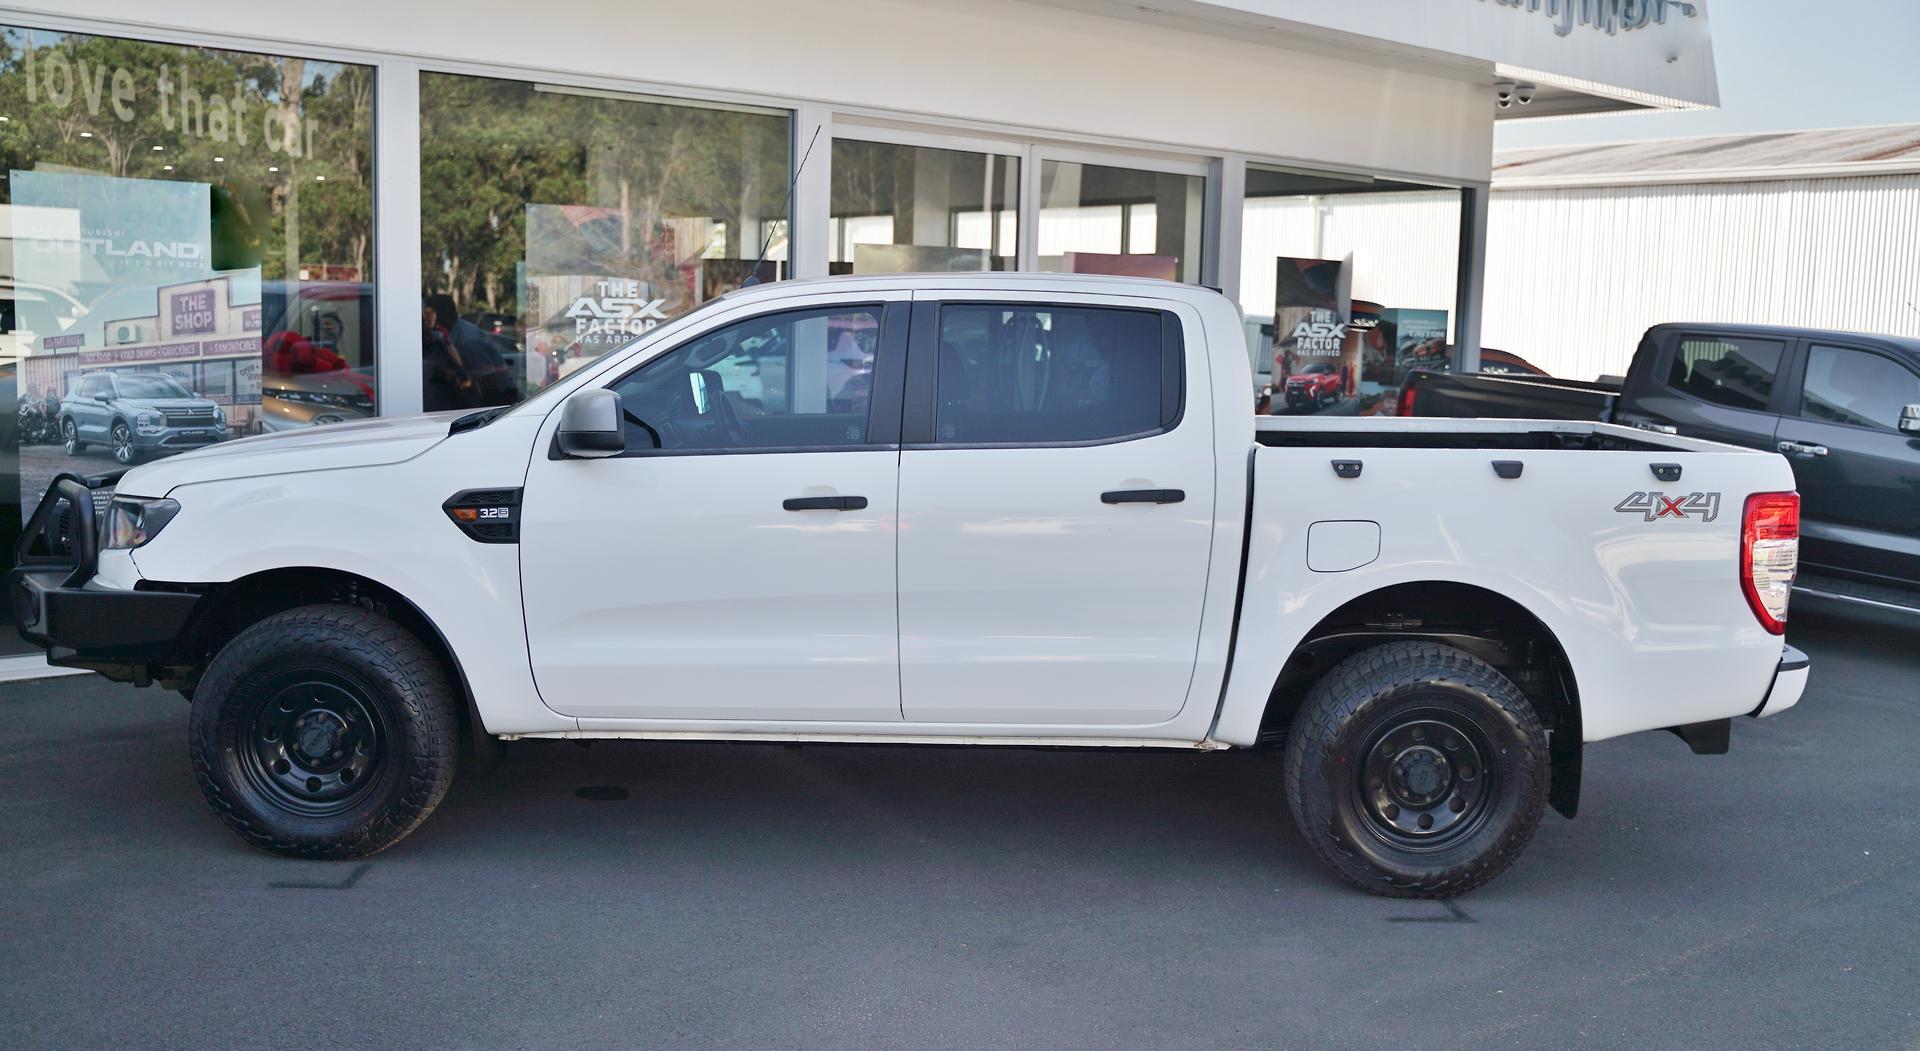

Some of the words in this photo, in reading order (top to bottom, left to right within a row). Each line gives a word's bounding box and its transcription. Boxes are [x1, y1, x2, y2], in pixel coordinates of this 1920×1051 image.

[25, 33, 136, 122] love
[157, 63, 248, 147] that
[263, 107, 319, 160] car
[596, 280, 639, 298] THE
[179, 294, 208, 313] THE
[565, 297, 669, 318] ASX
[174, 311, 213, 331] SHOP
[1309, 310, 1333, 323] THE
[575, 334, 600, 344] HAS
[1292, 321, 1346, 339] ASX
[213, 340, 257, 353] SANDWICHES
[1296, 336, 1341, 350] FACTOR
[1296, 349, 1311, 357] HAS
[1311, 349, 1341, 357] ARRIVED
